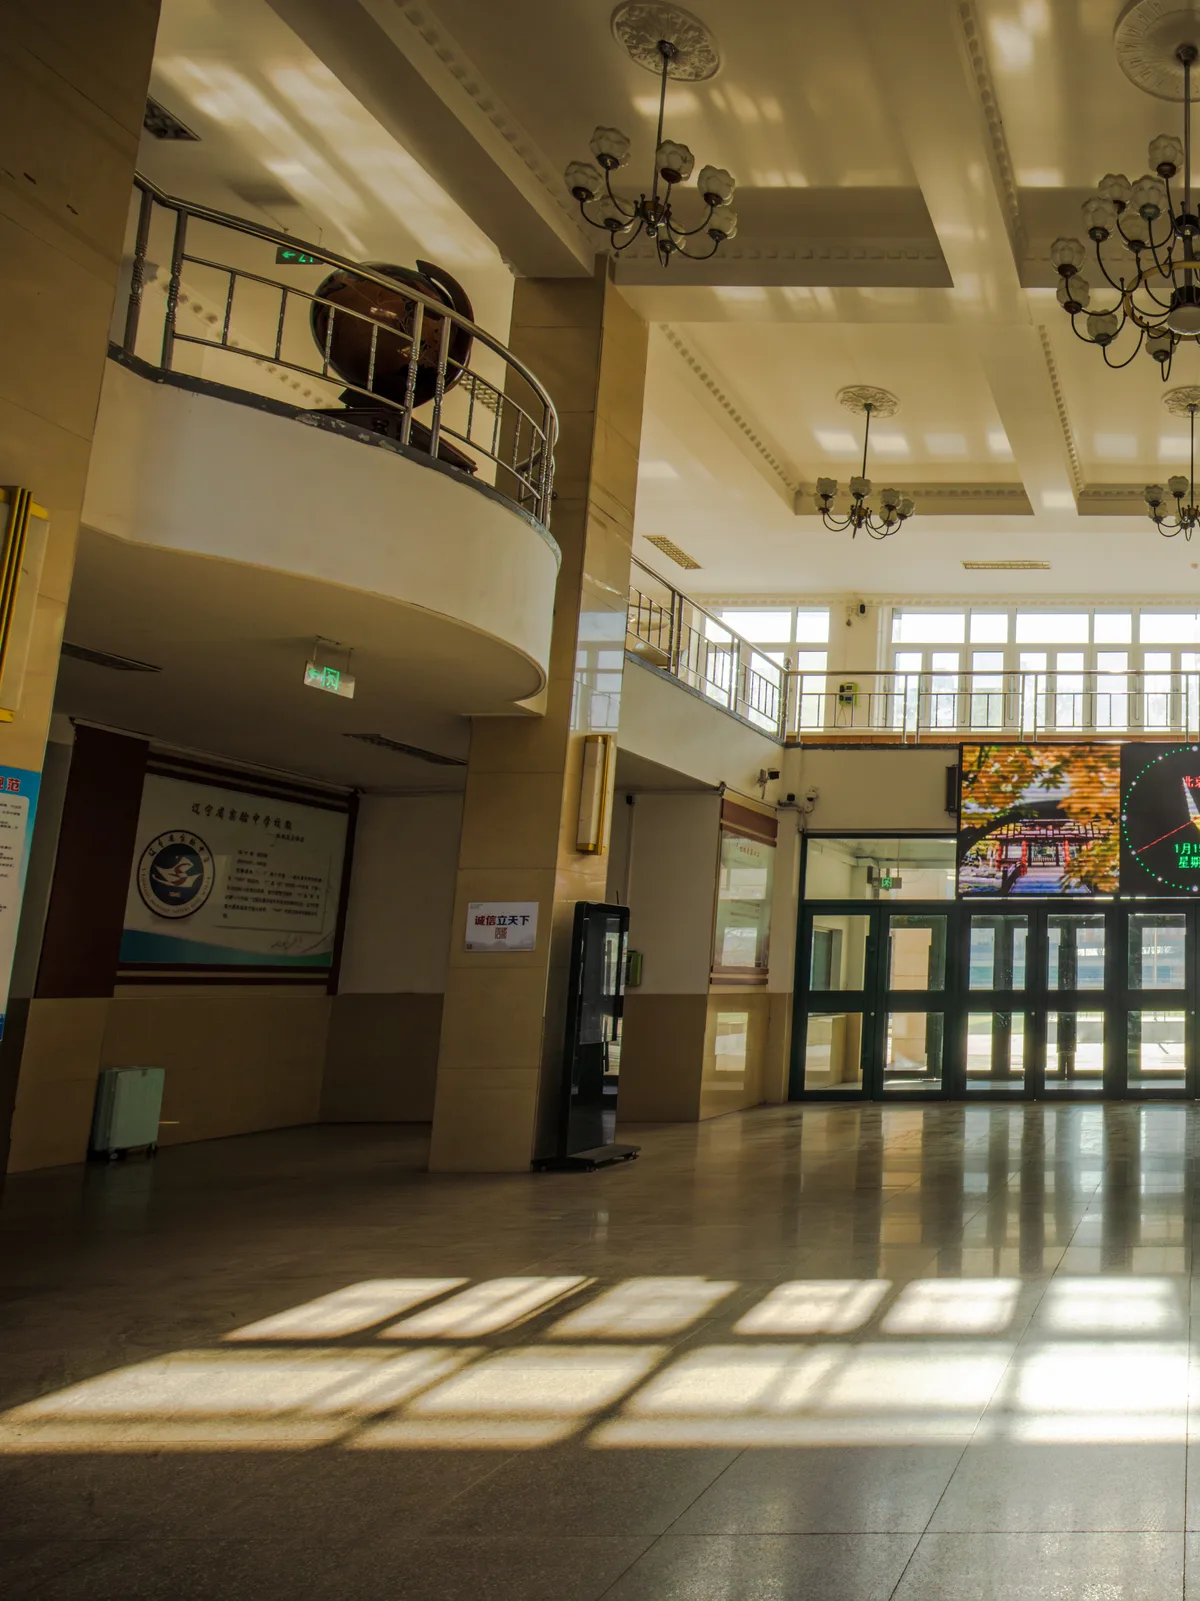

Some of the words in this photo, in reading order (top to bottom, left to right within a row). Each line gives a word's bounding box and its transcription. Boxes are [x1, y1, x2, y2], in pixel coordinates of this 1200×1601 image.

[475, 915, 530, 926] 诚信立天下
